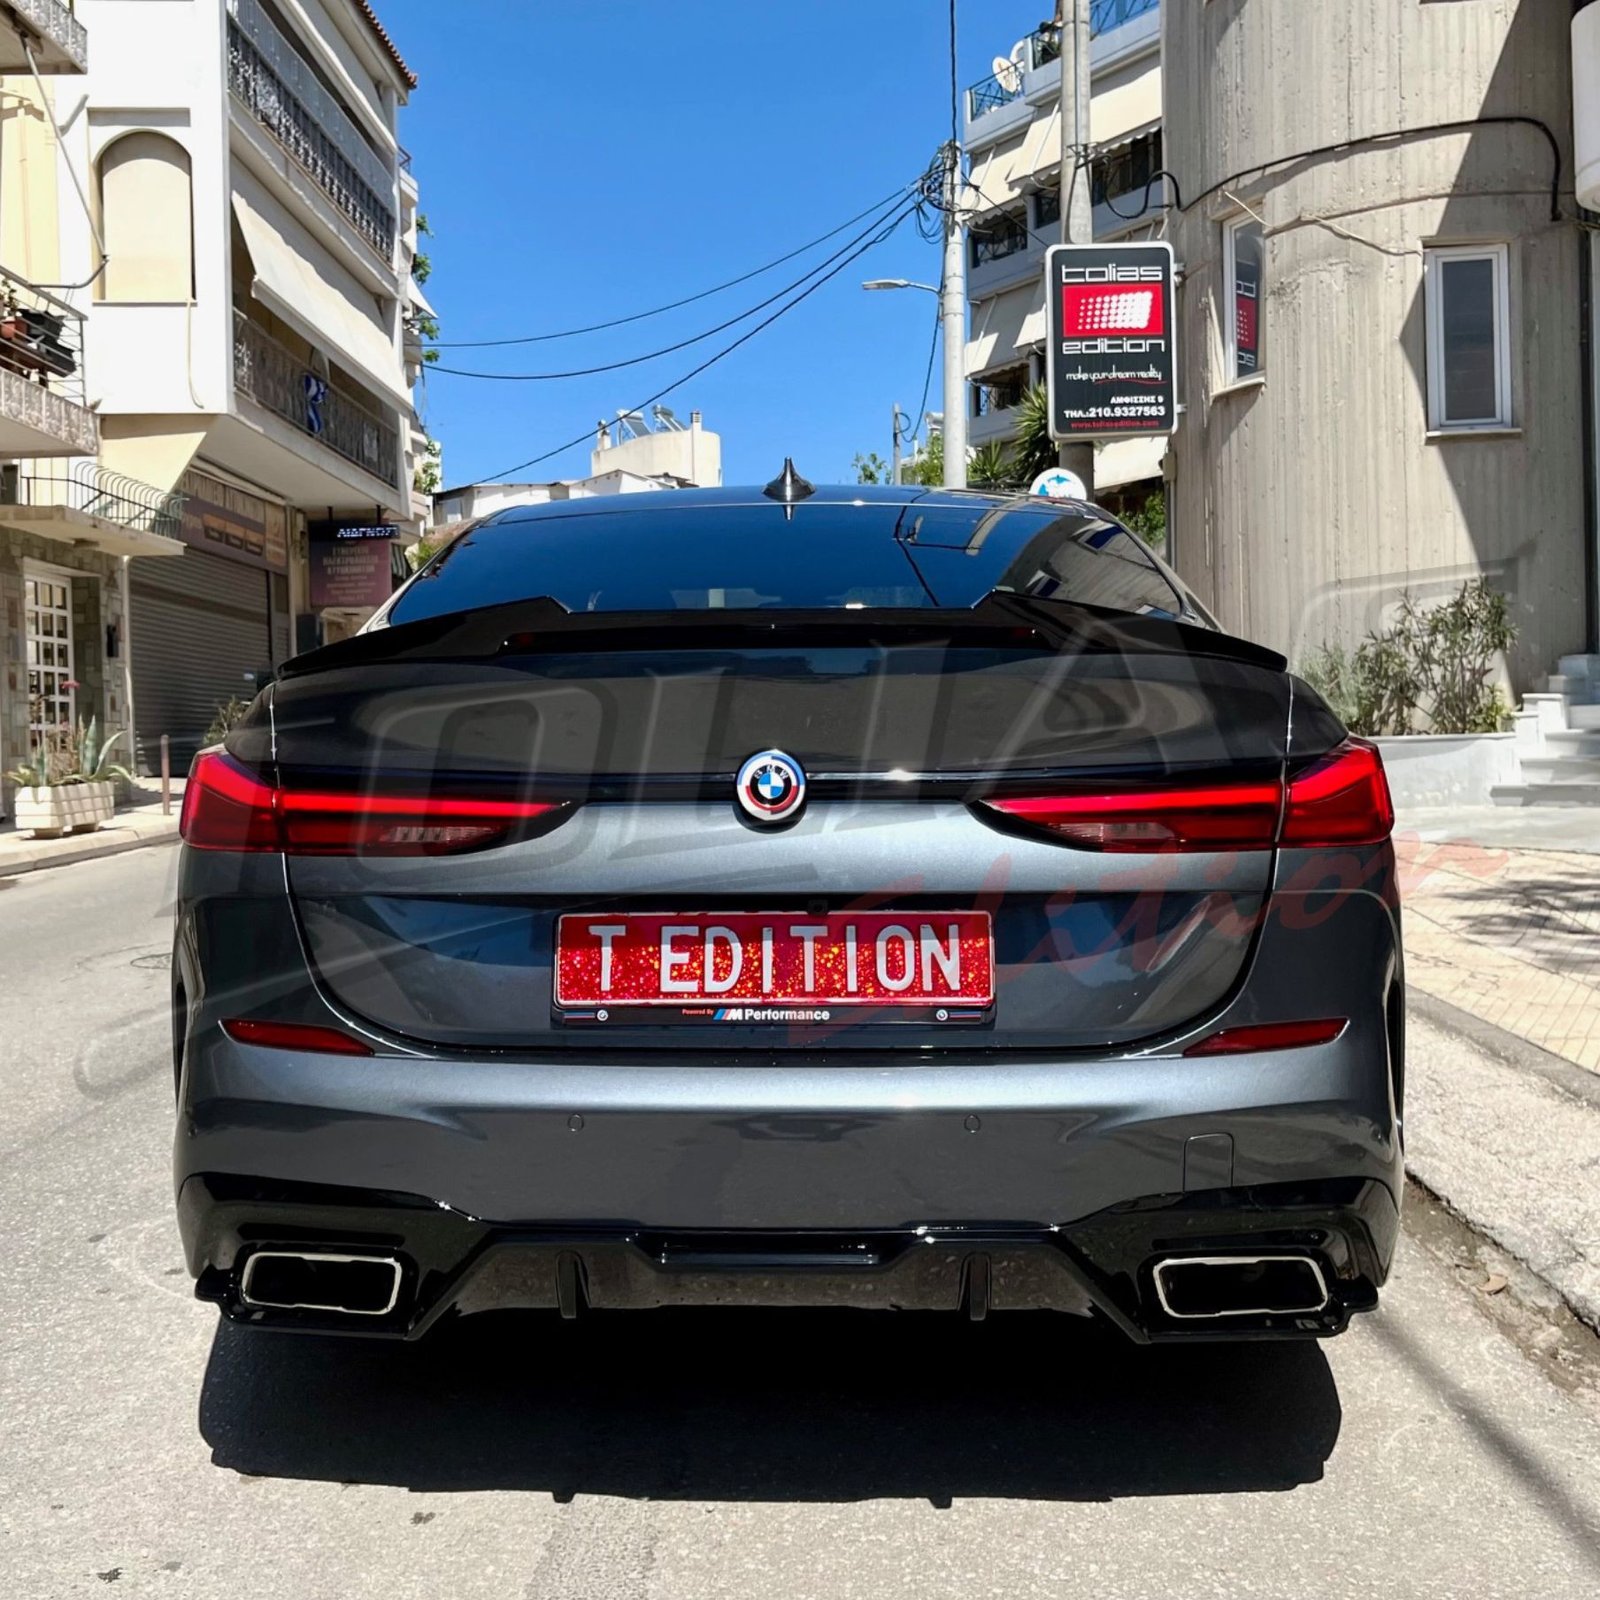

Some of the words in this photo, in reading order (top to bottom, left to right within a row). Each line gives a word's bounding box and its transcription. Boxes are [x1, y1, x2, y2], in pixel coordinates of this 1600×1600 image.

[1061, 263, 1163, 283] tolias
[1062, 337, 1165, 354] edition
[1065, 365, 1089, 381] make
[588, 924, 627, 993] T
[660, 924, 961, 994] EDITION
[745, 1008, 830, 1020] Performance
